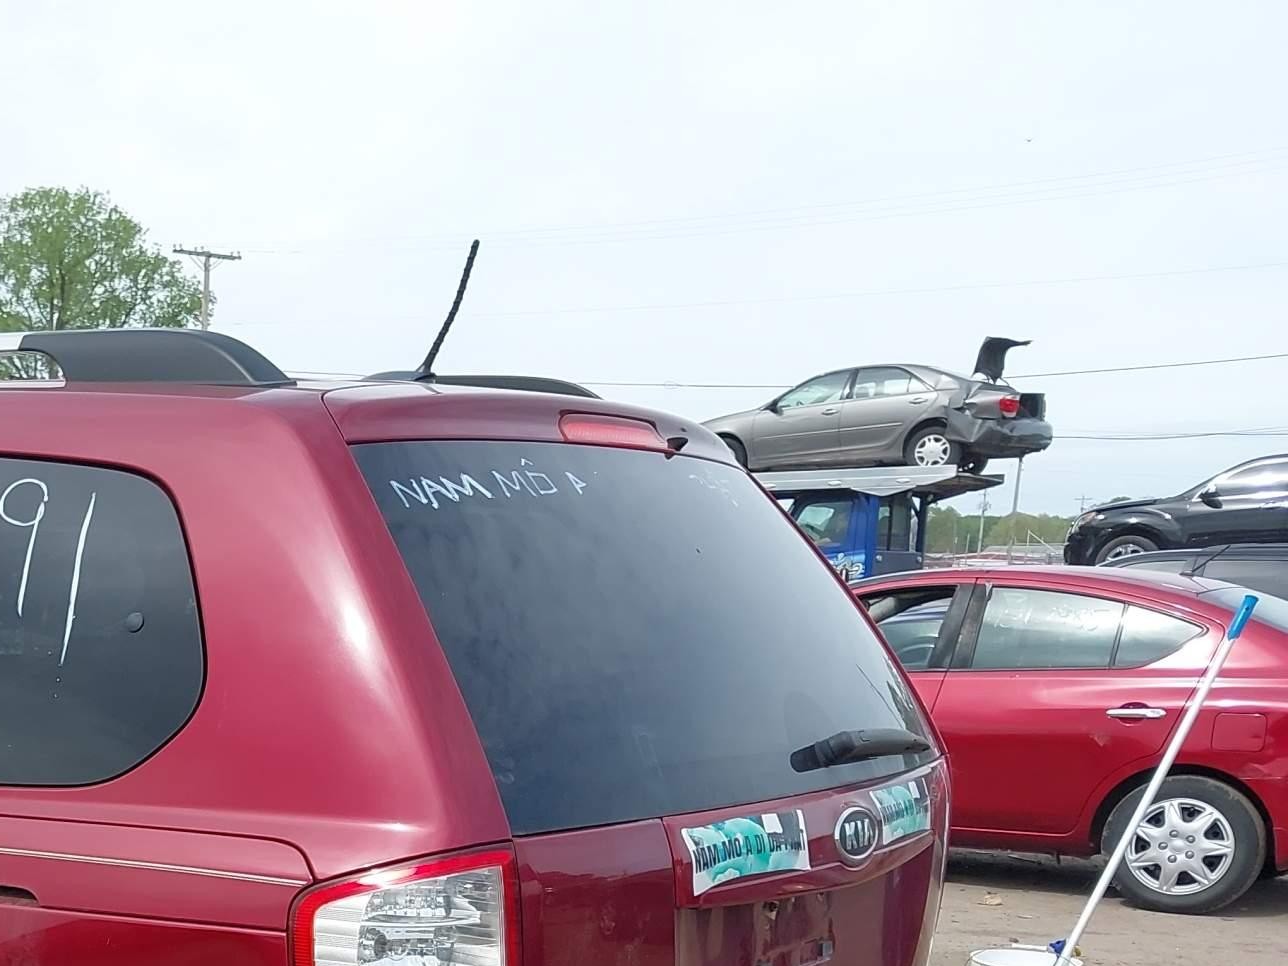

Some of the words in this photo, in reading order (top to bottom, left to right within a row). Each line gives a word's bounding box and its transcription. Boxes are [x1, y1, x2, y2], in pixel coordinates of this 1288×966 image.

[390, 473, 495, 509] NAM
[842, 818, 874, 851] KIA
[693, 843, 721, 874] NAM
[722, 837, 742, 861] MO
[743, 835, 753, 856] A
[755, 833, 766, 855] DI
